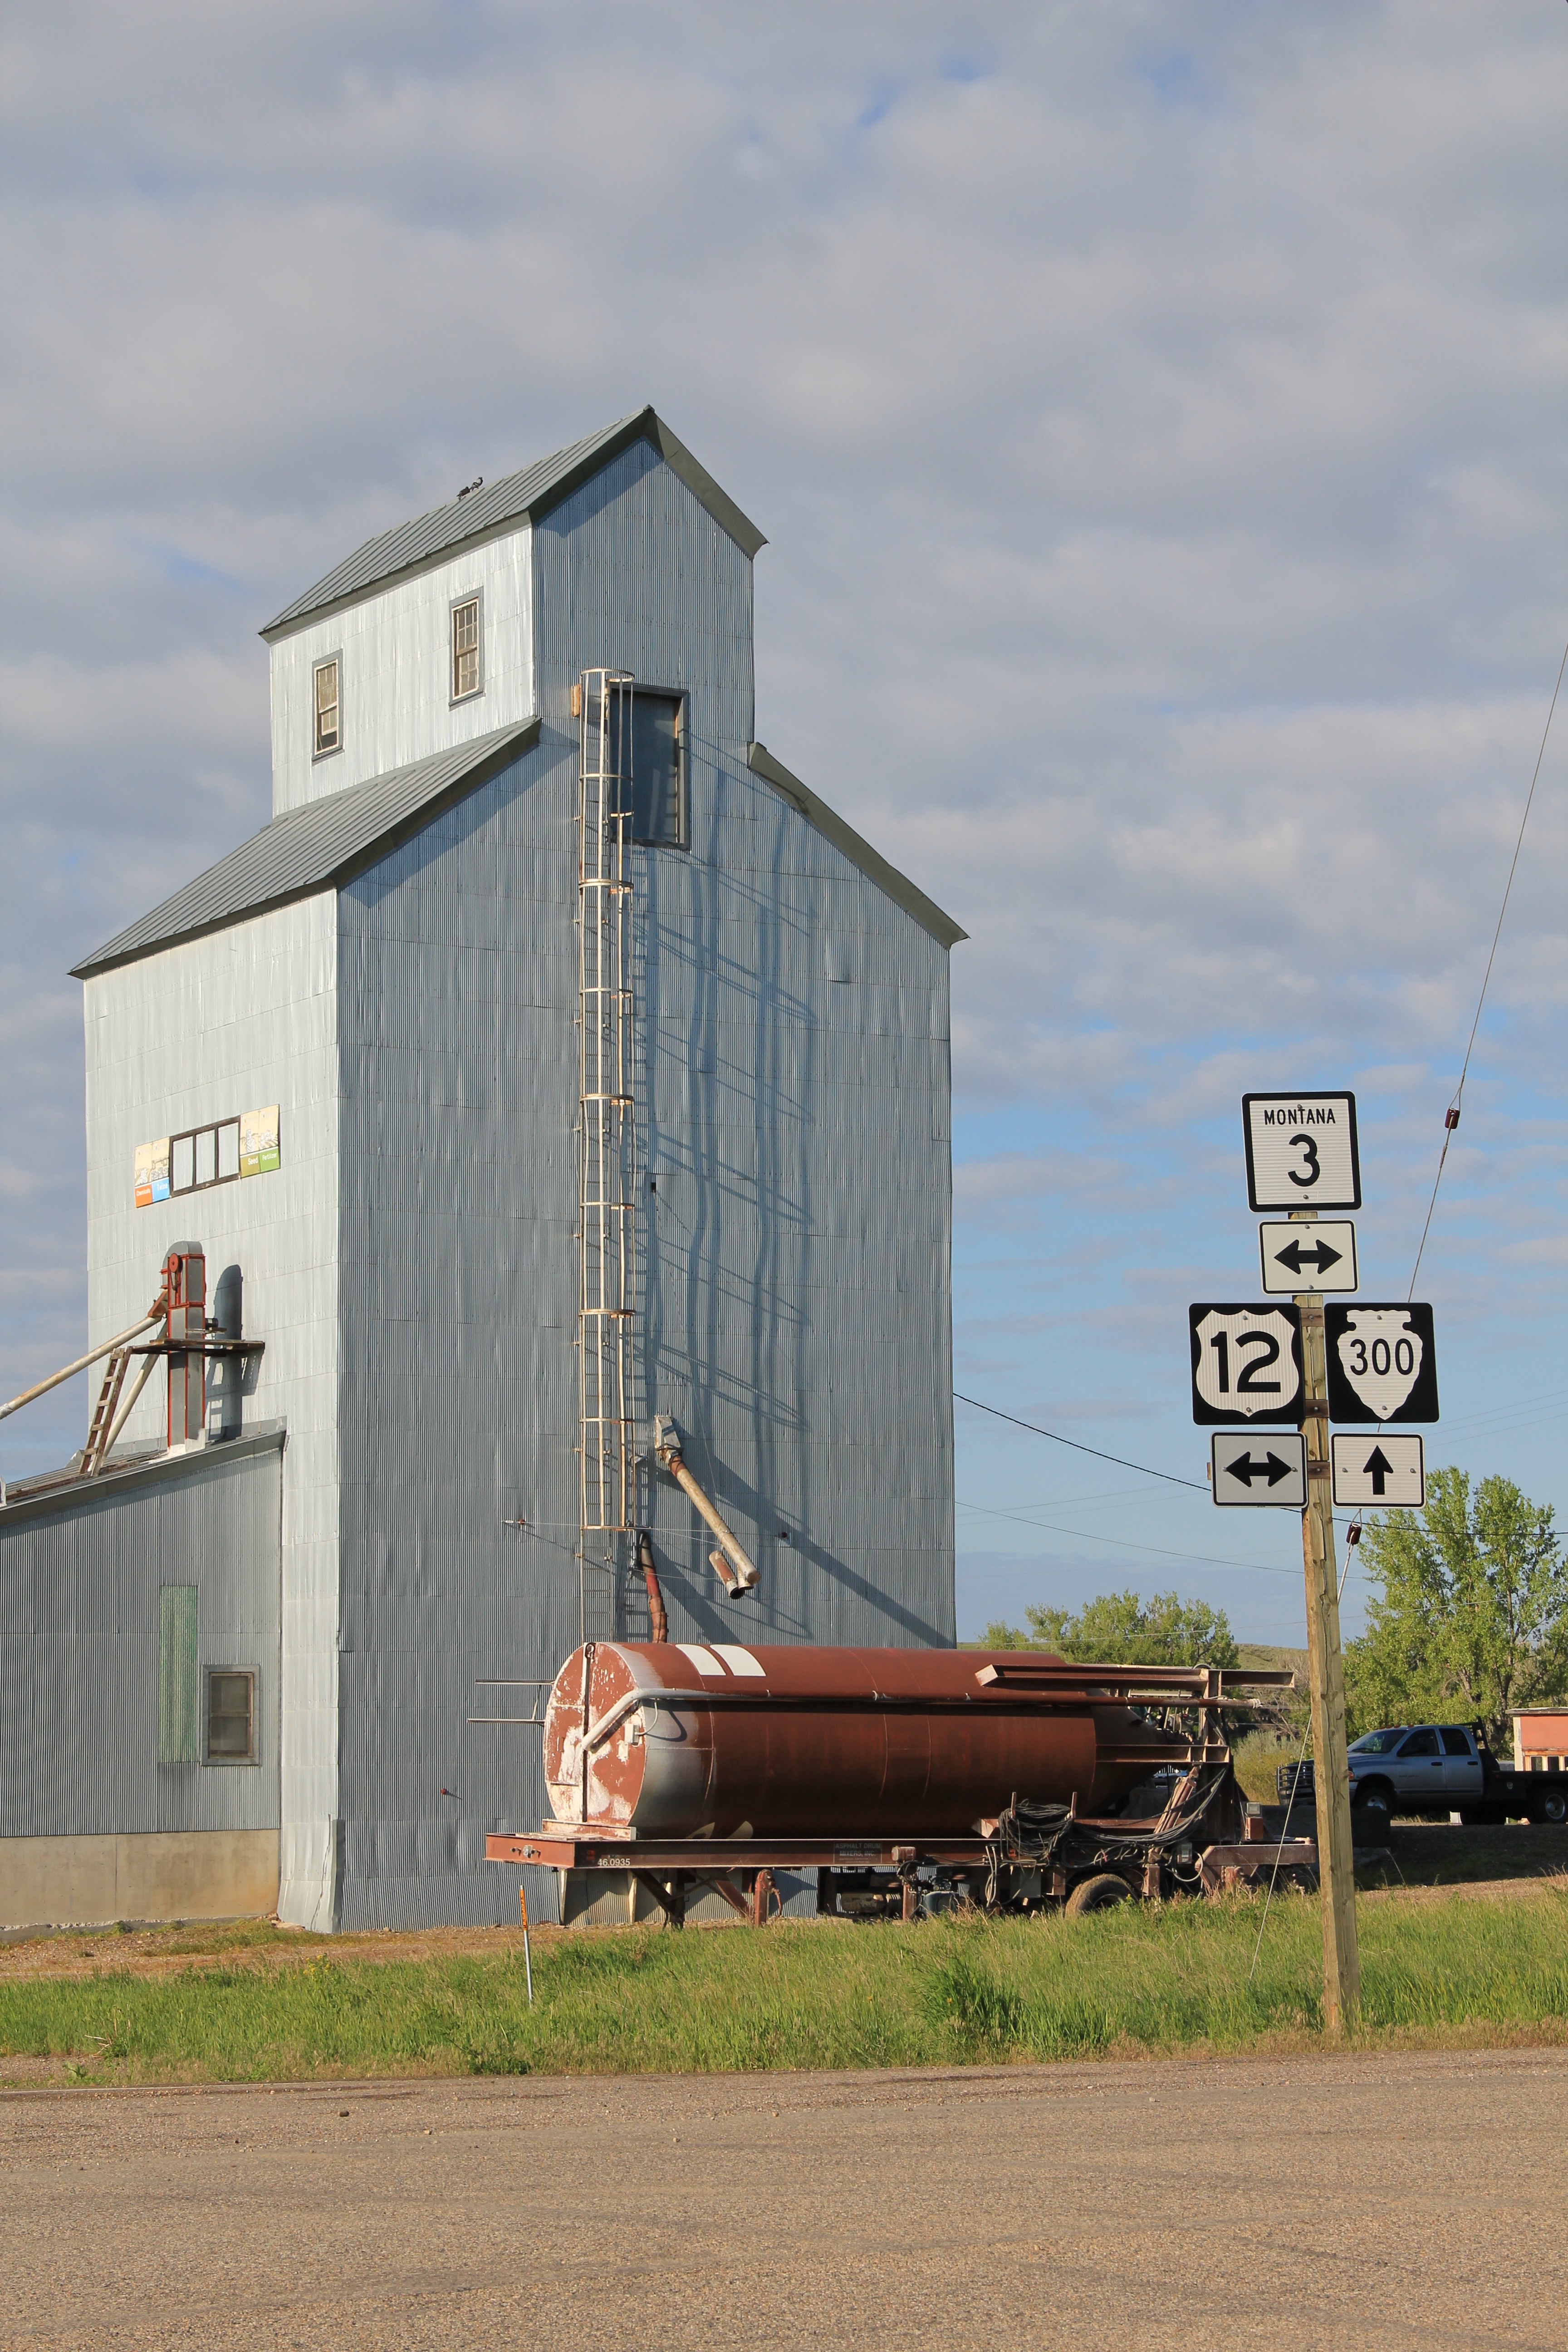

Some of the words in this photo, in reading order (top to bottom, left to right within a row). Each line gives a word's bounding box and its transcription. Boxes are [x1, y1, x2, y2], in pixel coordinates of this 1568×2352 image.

[1264, 1108, 1336, 1125] MONTANA
[248, 1156, 258, 1165] Seed
[262, 1152, 277, 1161] Fertilizer
[1288, 1134, 1320, 1187] 3
[137, 1187, 151, 1196] Chemicals
[157, 1183, 168, 1191] Twine
[1210, 1331, 1281, 1393] 12
[1350, 1338, 1414, 1375] 300
